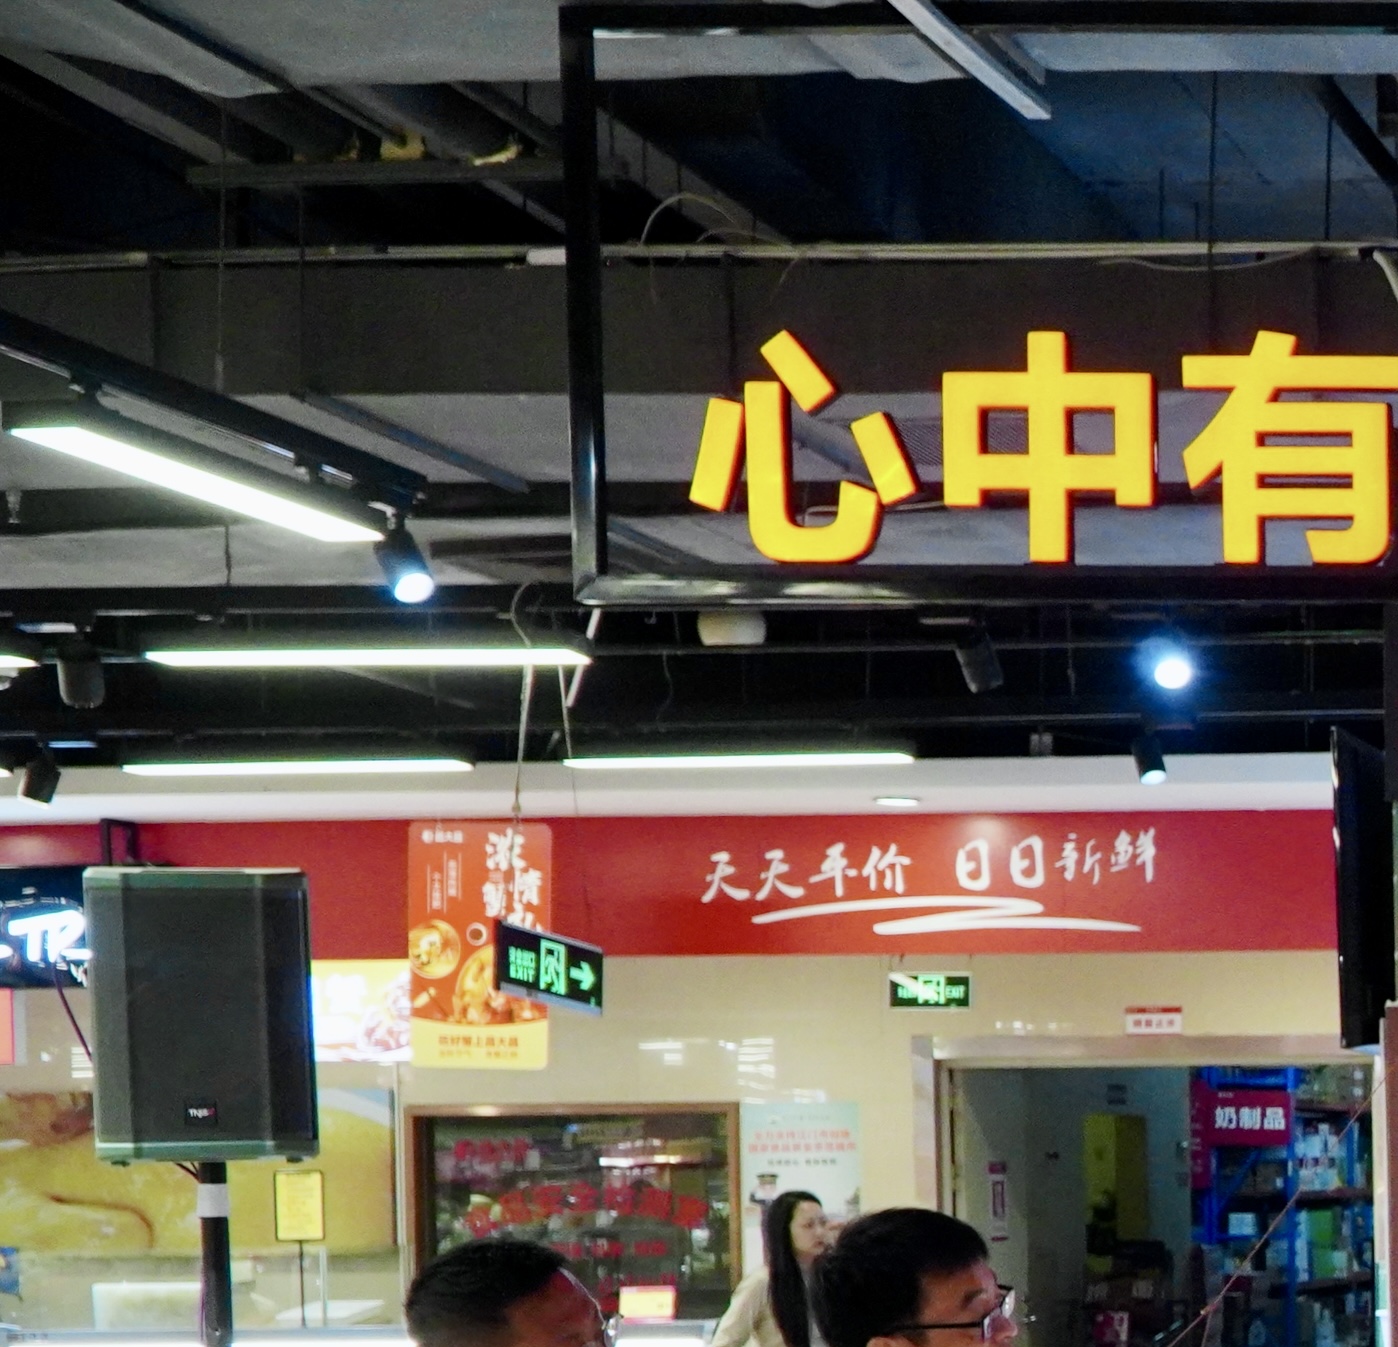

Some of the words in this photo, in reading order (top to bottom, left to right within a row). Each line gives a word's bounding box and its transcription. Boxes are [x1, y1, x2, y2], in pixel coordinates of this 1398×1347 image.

[702, 842, 912, 900] 天天平价
[955, 828, 1156, 891] 日日新鲜
[1215, 1106, 1286, 1131] 奶制品
